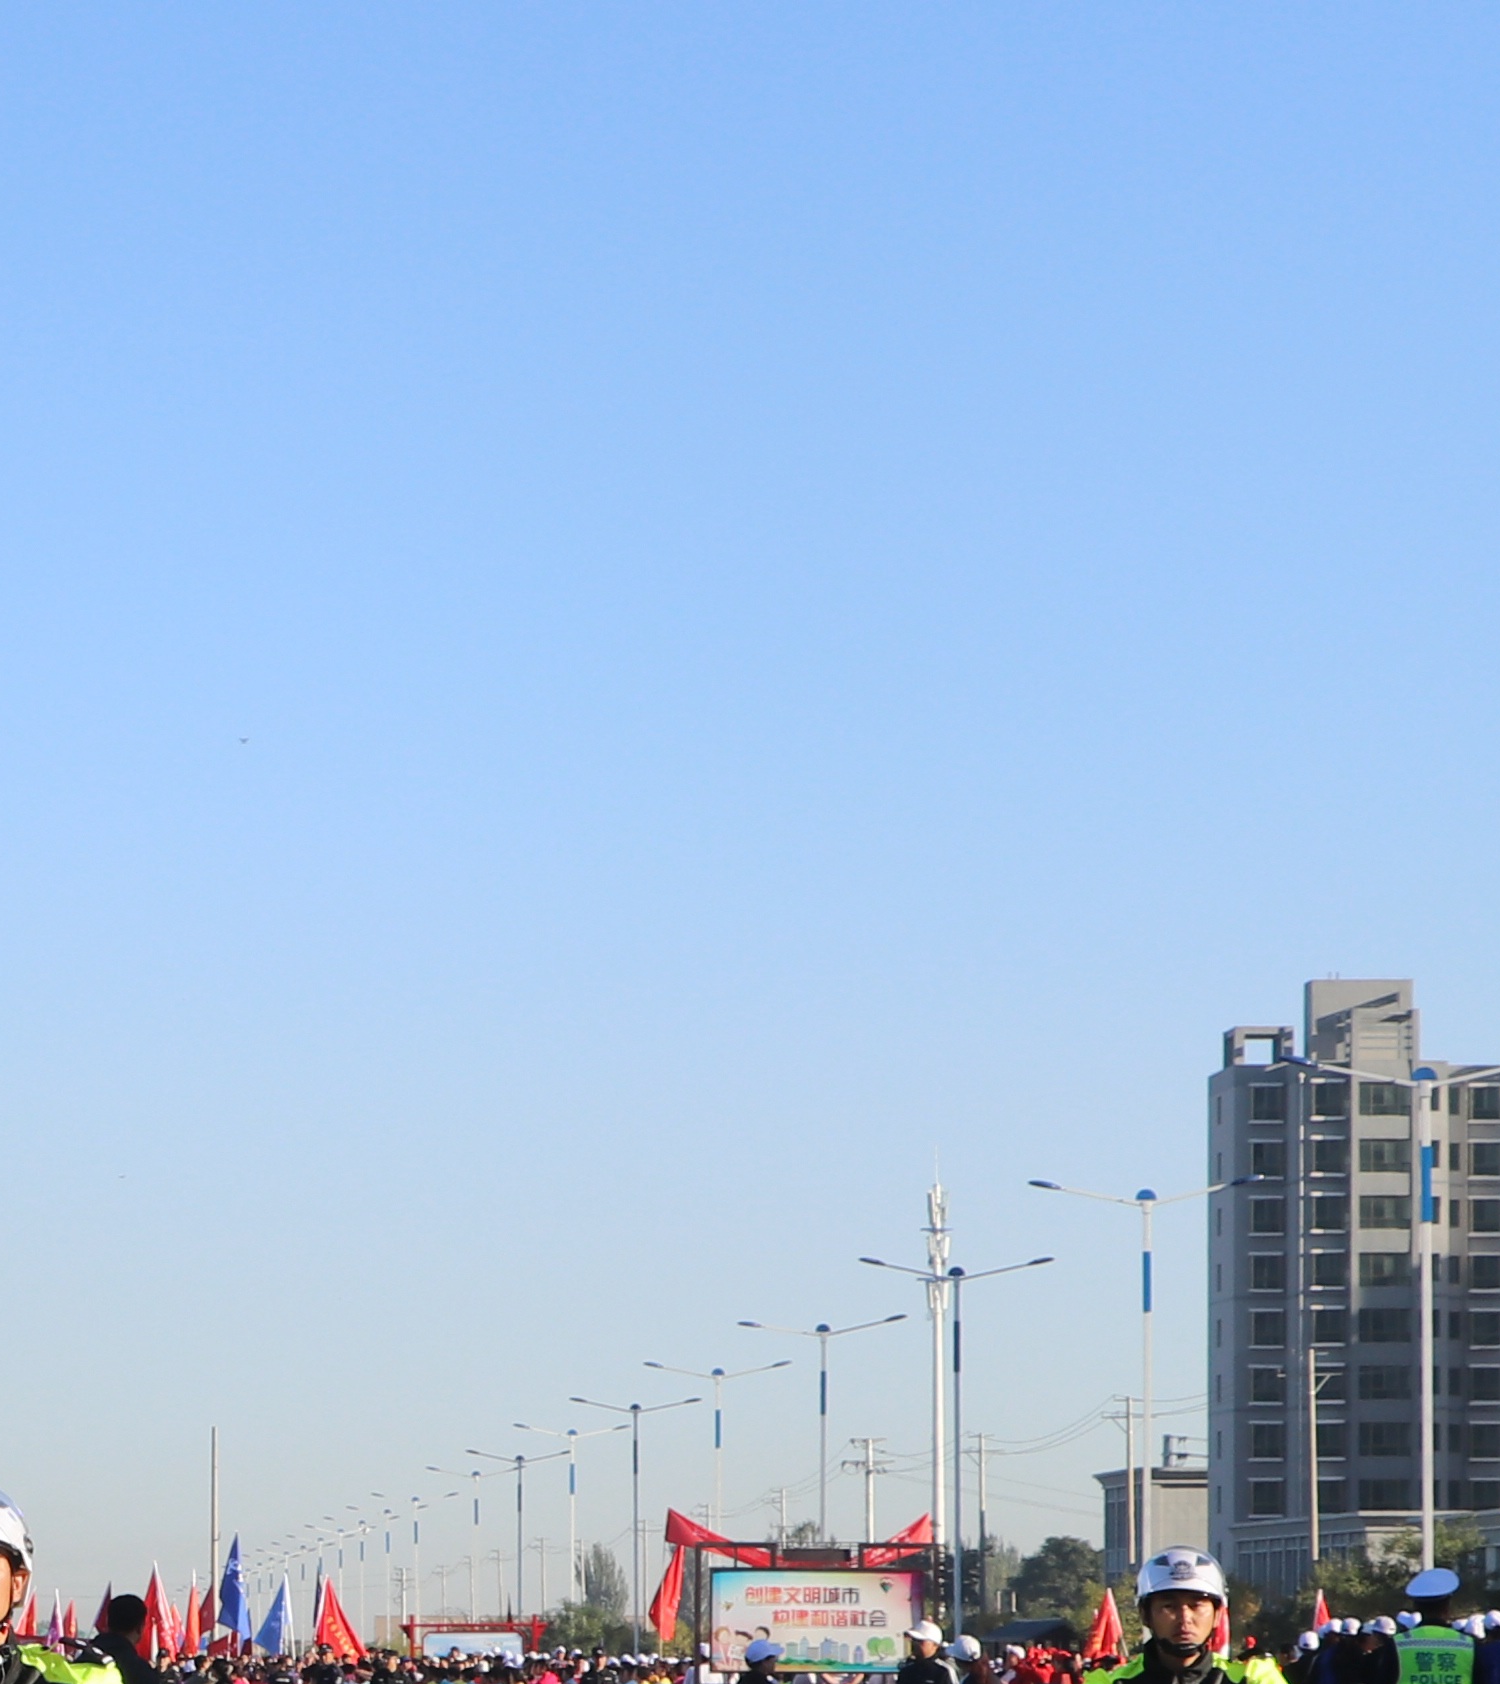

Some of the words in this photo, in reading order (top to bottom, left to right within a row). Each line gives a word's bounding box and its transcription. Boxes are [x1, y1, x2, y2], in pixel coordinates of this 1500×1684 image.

[745, 1586, 860, 1604] 创建文明城市
[772, 1609, 887, 1627] 构建和谐社会
[1415, 1651, 1458, 1672] 警察
